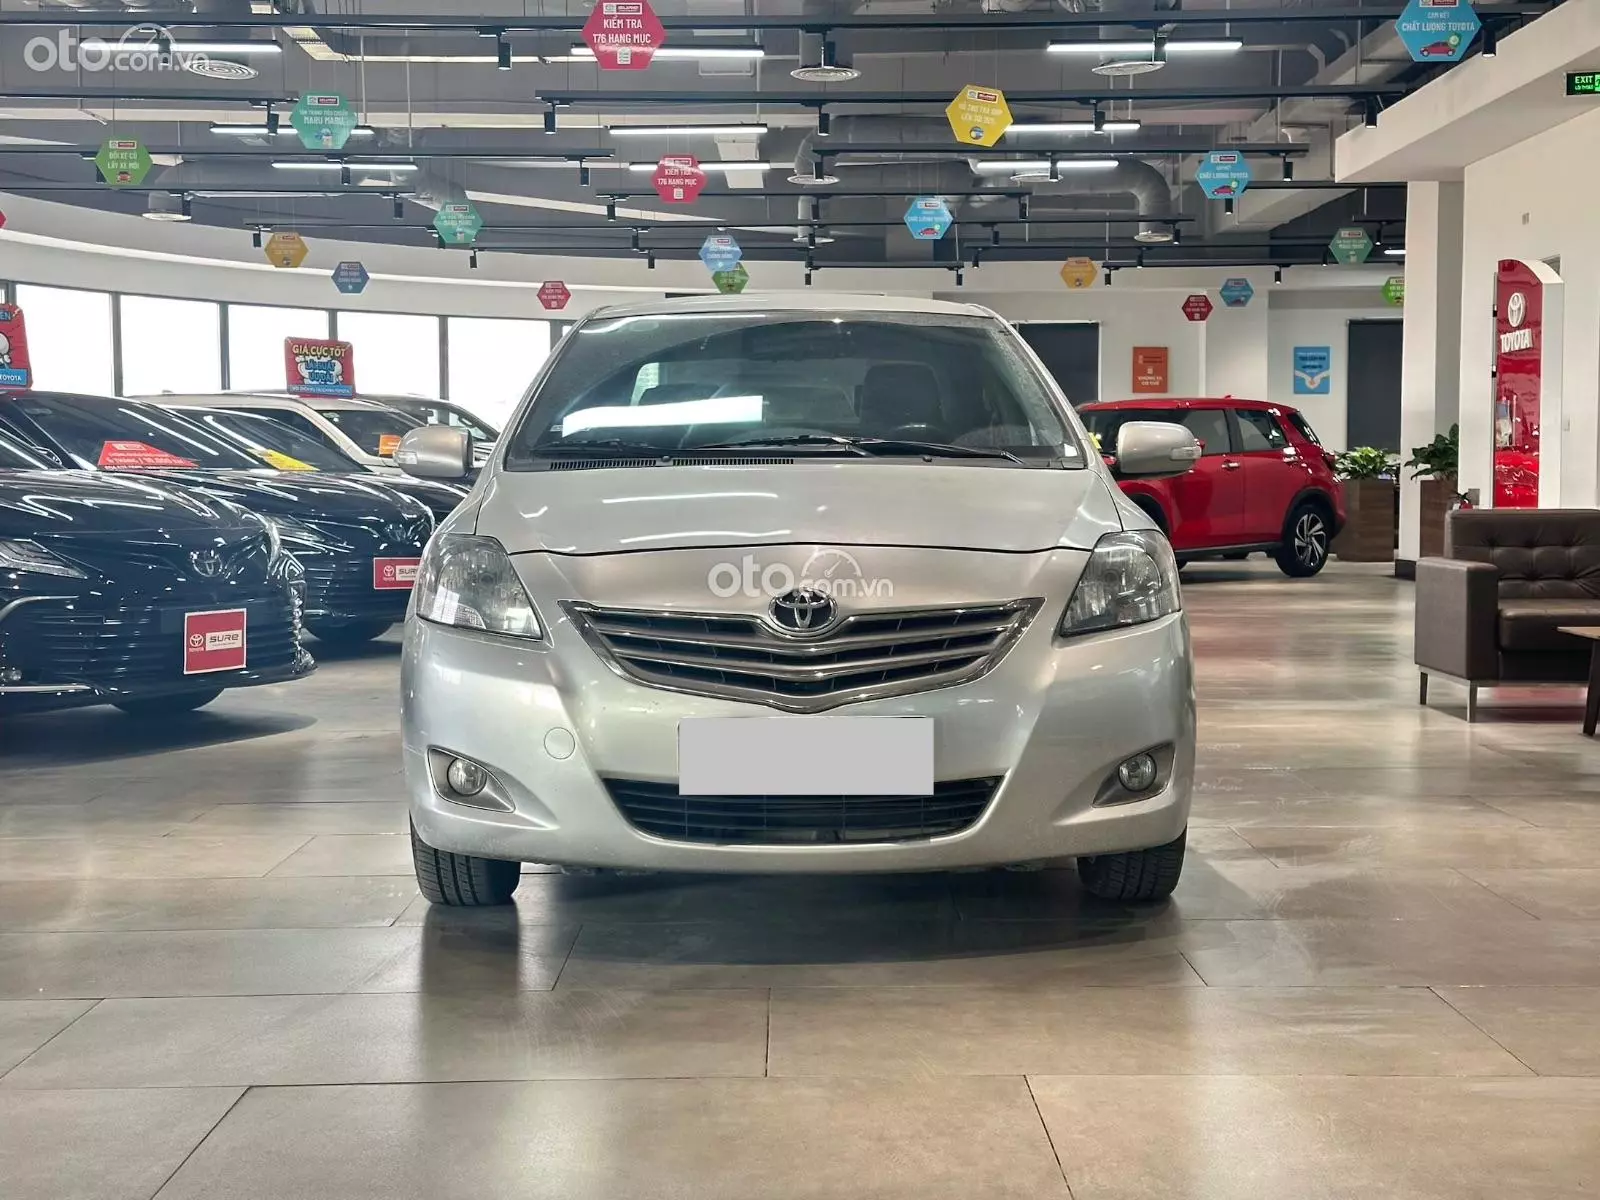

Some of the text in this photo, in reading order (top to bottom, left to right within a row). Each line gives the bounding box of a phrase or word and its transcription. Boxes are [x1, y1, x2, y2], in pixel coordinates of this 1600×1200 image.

[603, 14, 643, 29] KIỂM TRA
[1402, 21, 1420, 31] CHẤT
[1448, 22, 1475, 31] TOYOTA
[608, 33, 632, 46] HẠNG
[633, 33, 652, 45] MỤC
[1575, 75, 1593, 84] EXIT
[1500, 328, 1533, 353] TOYOTA
[292, 343, 346, 358] GIÁ CỰC TỐT
[209, 633, 240, 643] SURE
